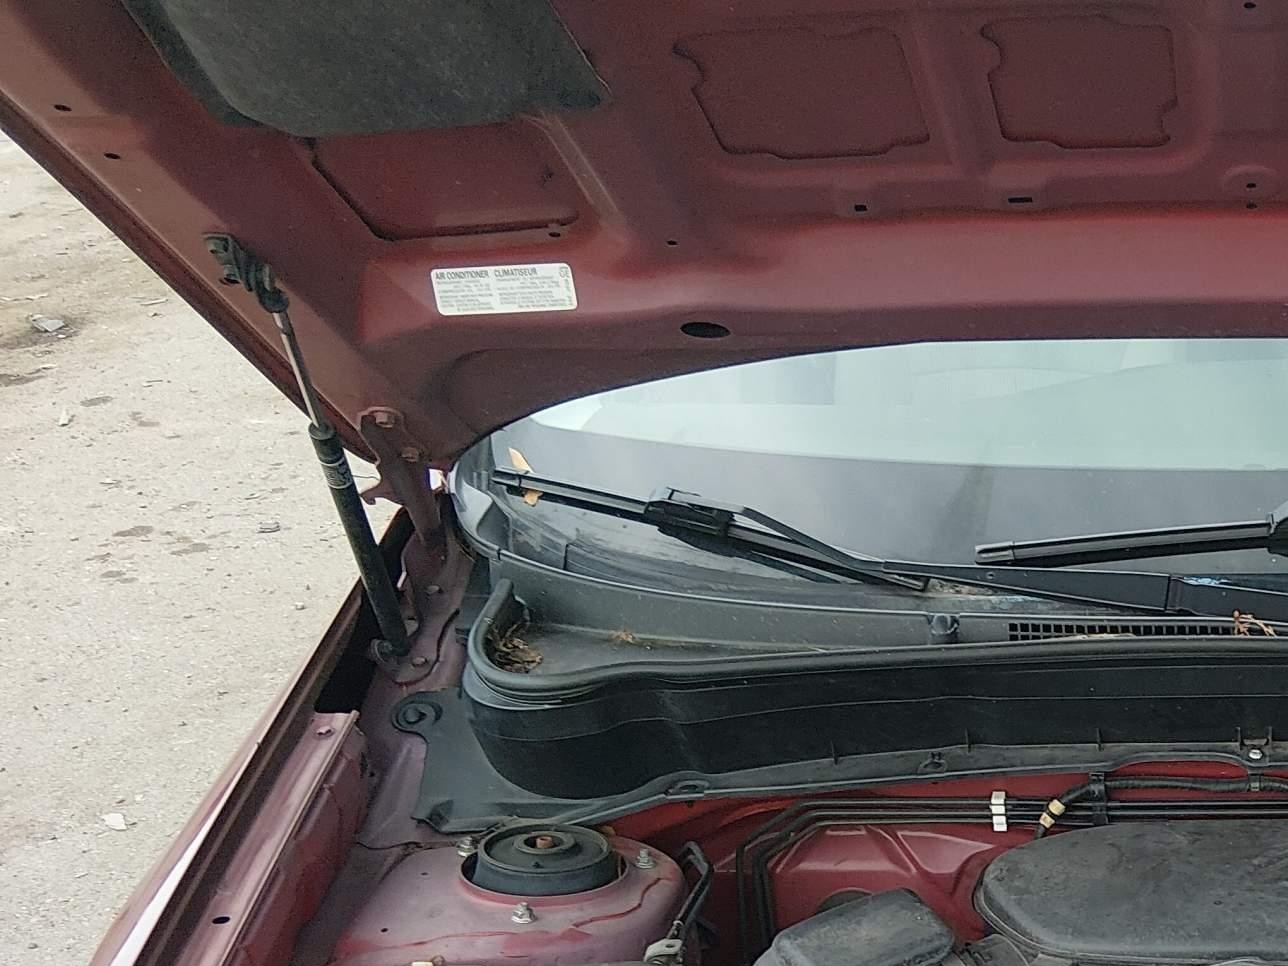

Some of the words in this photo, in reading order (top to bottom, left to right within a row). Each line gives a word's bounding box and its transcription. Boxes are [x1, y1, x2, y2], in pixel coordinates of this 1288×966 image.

[436, 271, 446, 280] AIR
[447, 269, 489, 280] CONDITIONER
[494, 267, 538, 278] CLIMATISEUR
